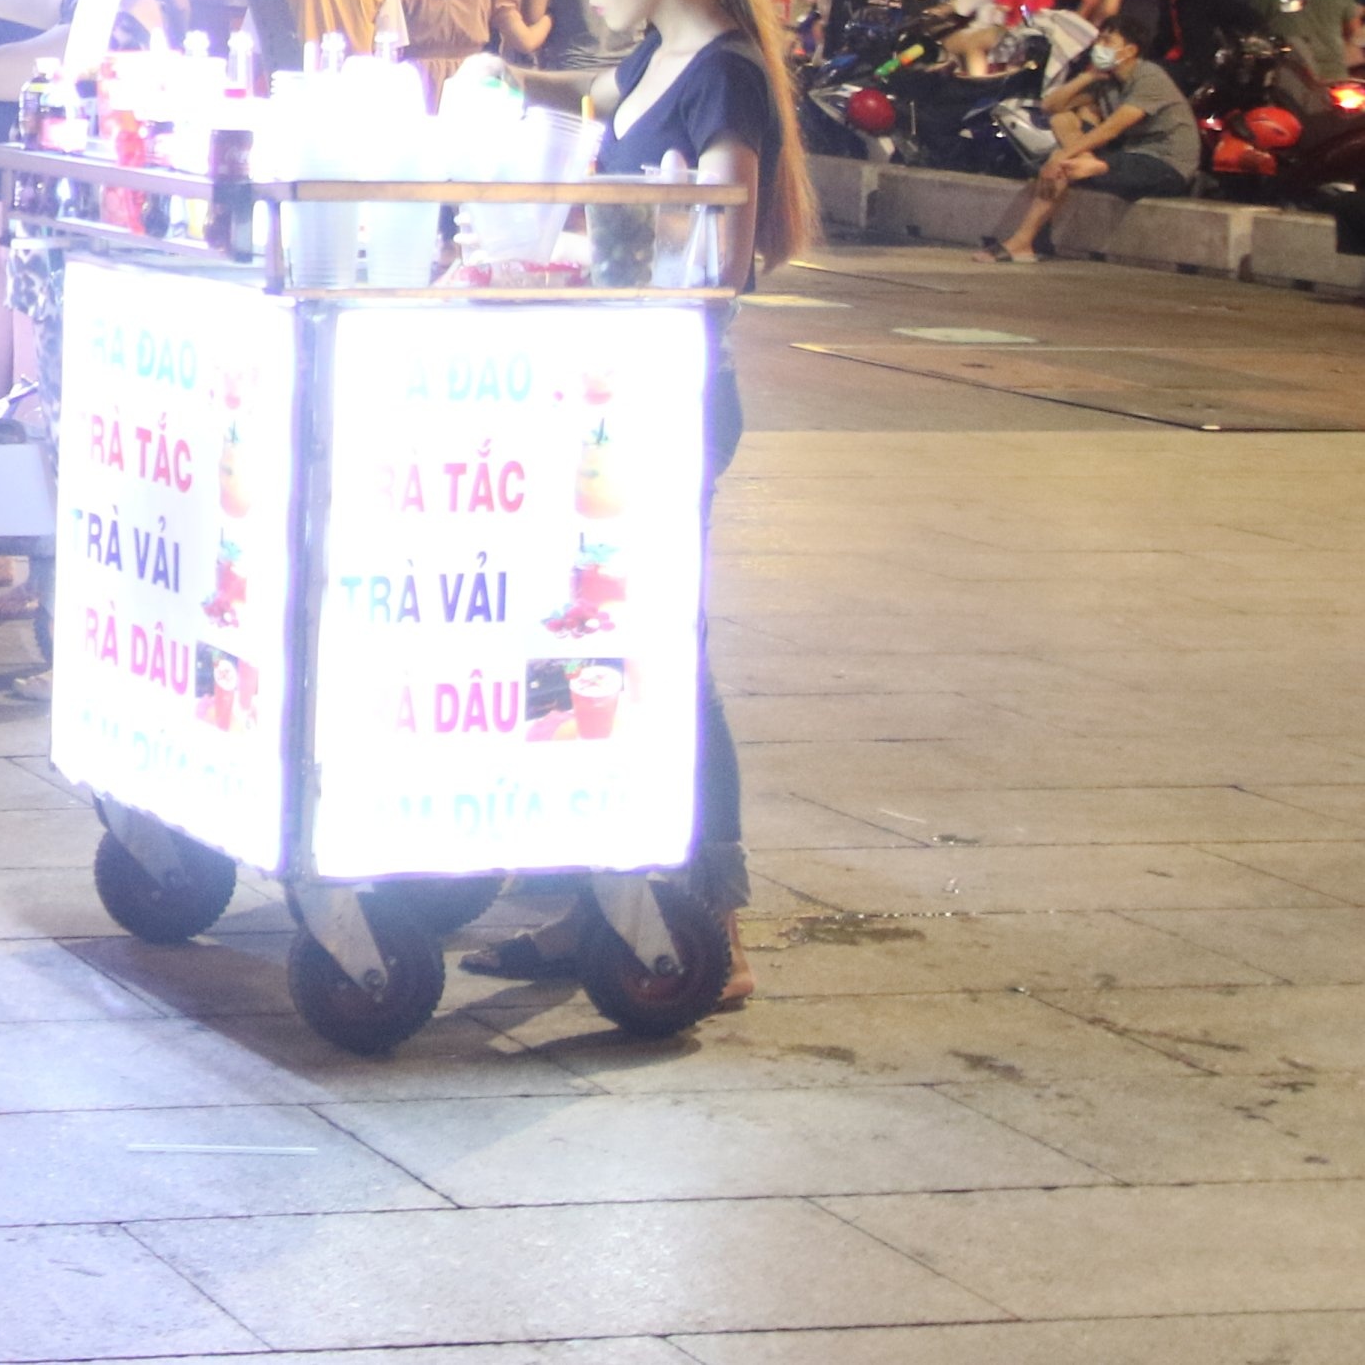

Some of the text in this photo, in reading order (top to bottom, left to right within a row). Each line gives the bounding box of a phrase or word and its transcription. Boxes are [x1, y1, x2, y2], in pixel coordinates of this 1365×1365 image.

[134, 412, 193, 493] TẮC
[442, 437, 526, 513] TẮC
[132, 515, 181, 594] VẢI
[439, 550, 508, 623] VẢI
[130, 621, 191, 697] DÂU
[433, 668, 520, 734] DÂU
